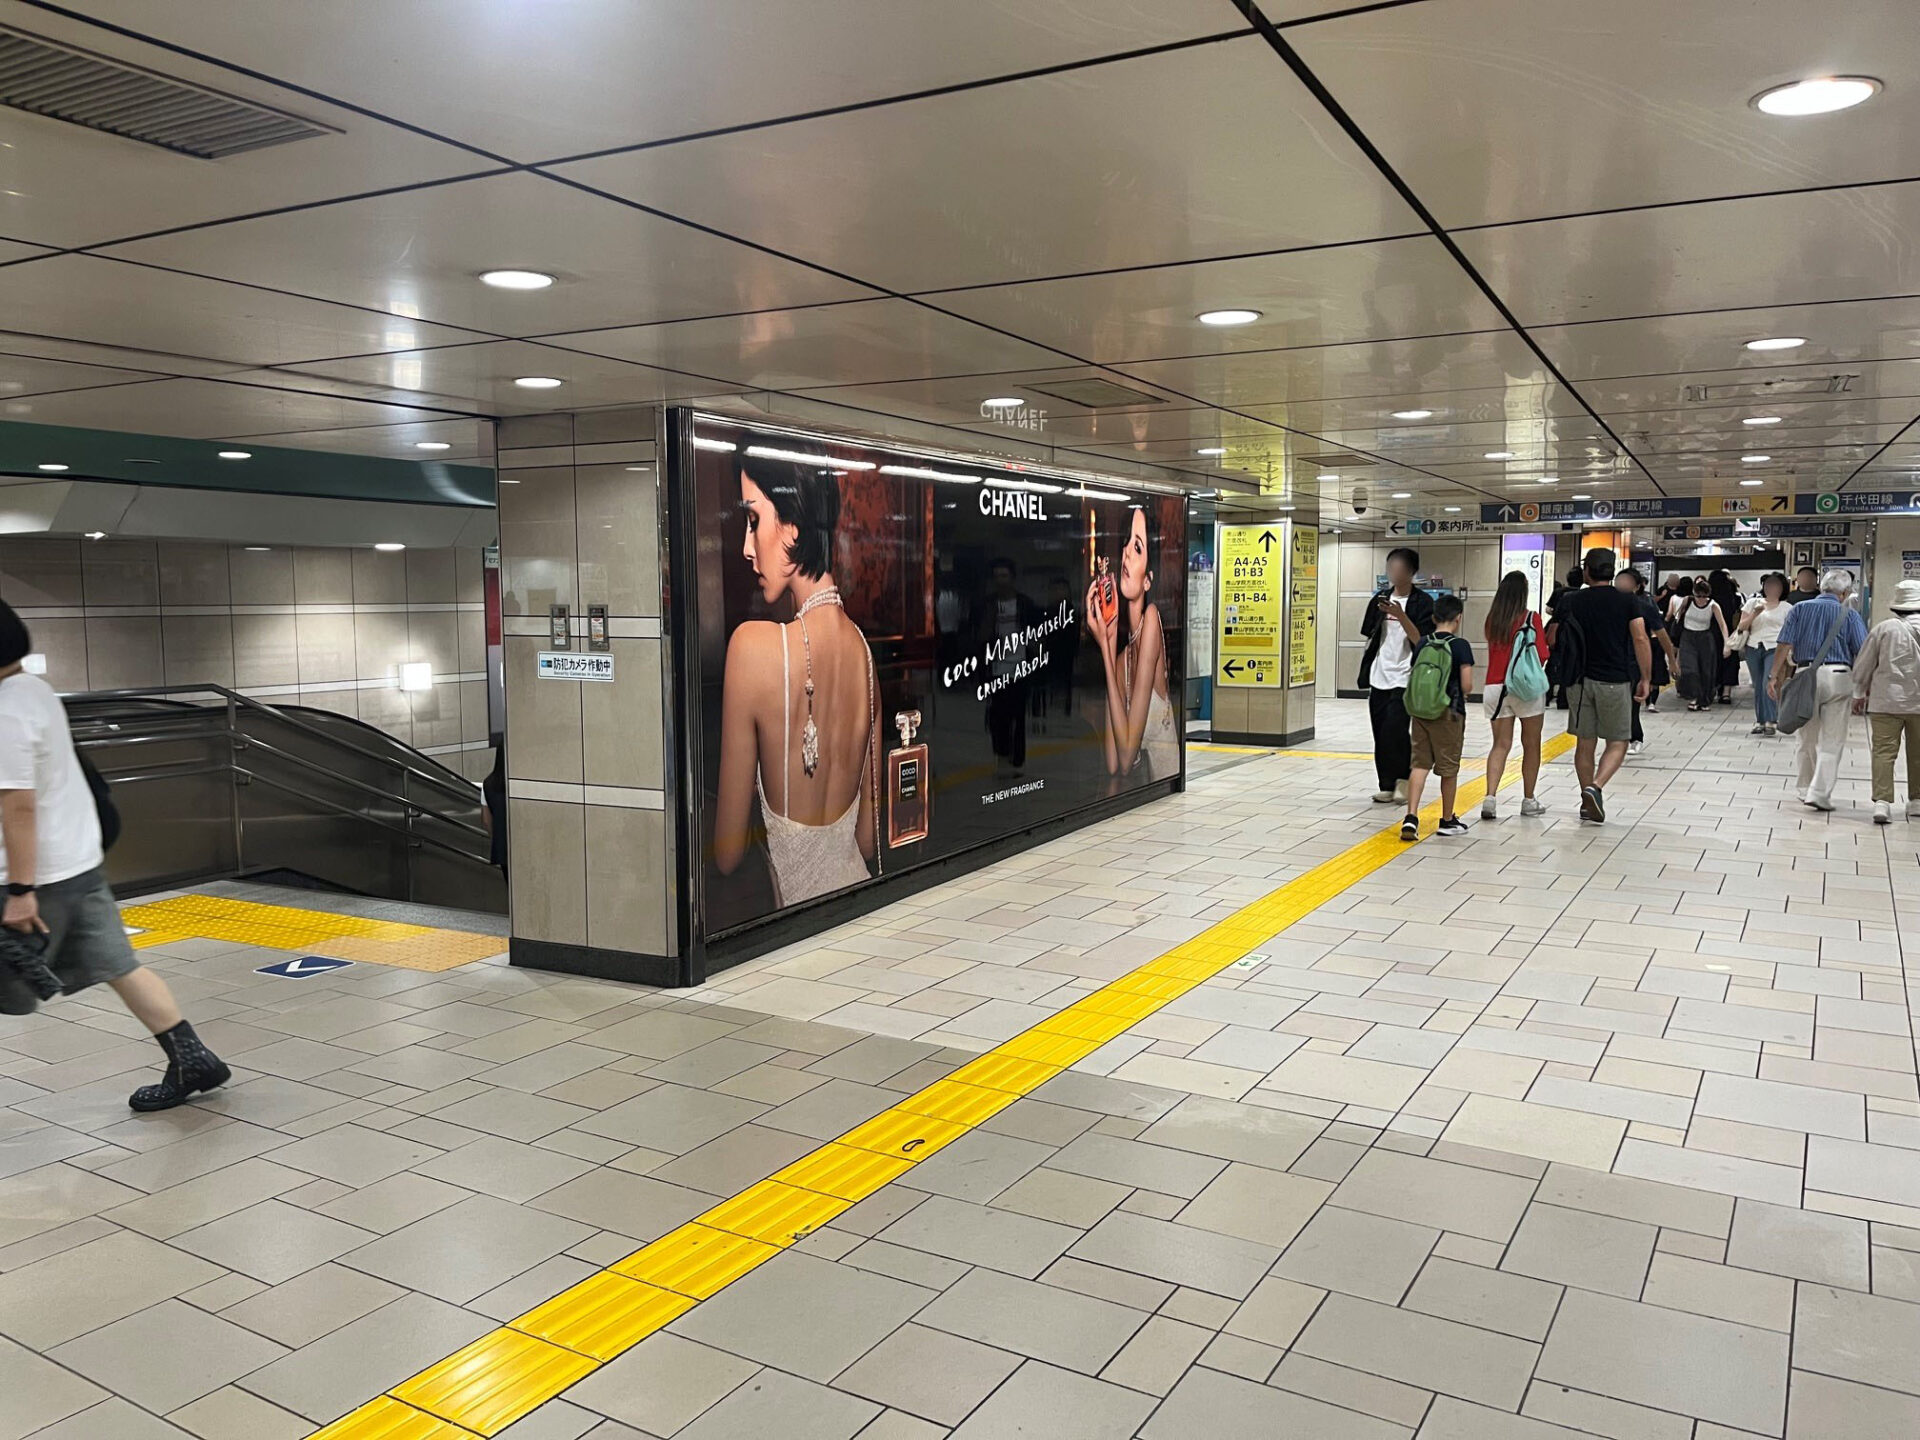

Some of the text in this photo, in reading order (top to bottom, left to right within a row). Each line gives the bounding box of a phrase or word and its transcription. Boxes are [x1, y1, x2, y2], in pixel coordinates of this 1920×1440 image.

[978, 488, 1047, 521] CHANEL
[1841, 494, 1893, 505] 千代田線
[1541, 504, 1574, 514] 銀座線
[1616, 501, 1663, 512] 半蔵門線
[1438, 520, 1474, 532] 案内所
[1530, 554, 1539, 568] 6
[553, 657, 611, 673] 防犯カメラ作動中
[943, 655, 979, 688] COCO
[976, 642, 1050, 702] CRUSH ABSOLU
[902, 767, 916, 777] COCO
[901, 784, 916, 794] CHANEL
[981, 779, 1045, 805] THE NEW FRAGRANCE
